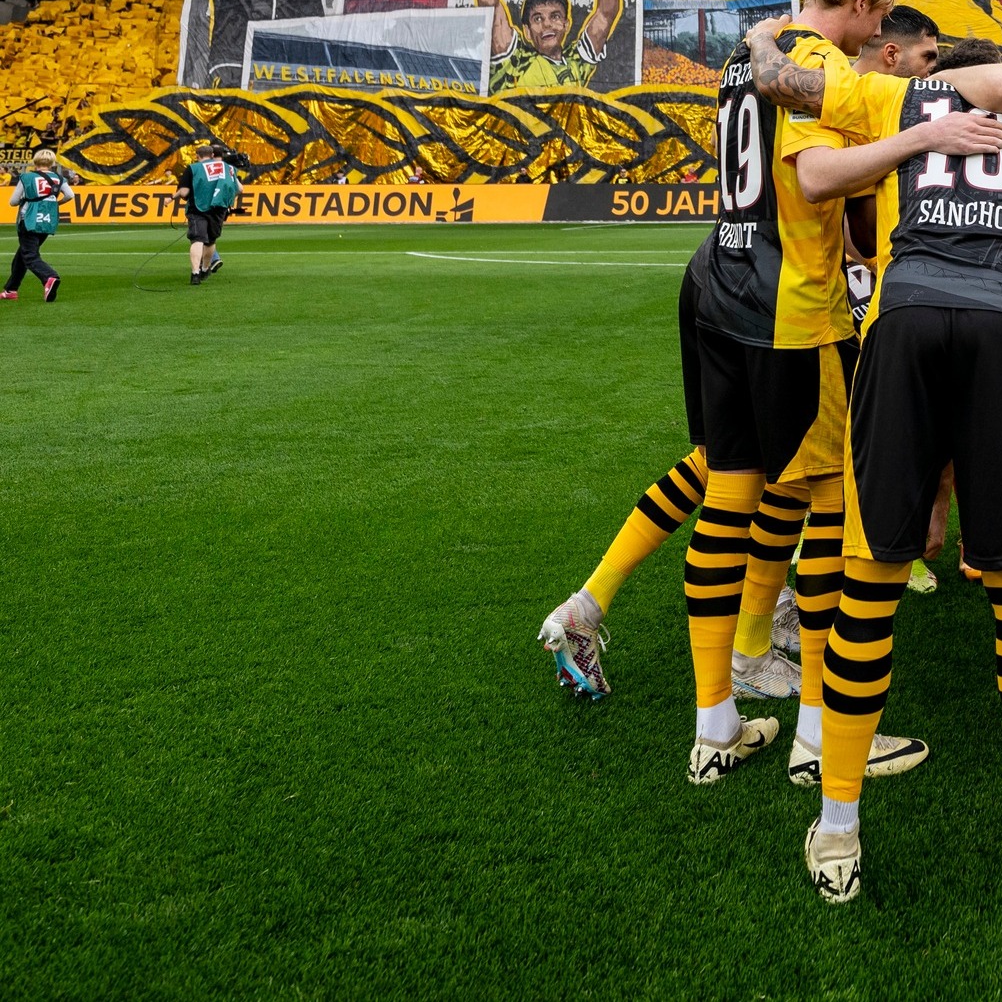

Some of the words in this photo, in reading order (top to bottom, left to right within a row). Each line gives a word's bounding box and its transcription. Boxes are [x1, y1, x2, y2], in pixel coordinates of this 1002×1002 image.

[252, 62, 478, 94] WESTFALENSTADION
[717, 94, 762, 210] 19
[75, 191, 433, 218] WESTFENSTADION
[611, 190, 650, 216] 50
[35, 212, 52, 224] 24
